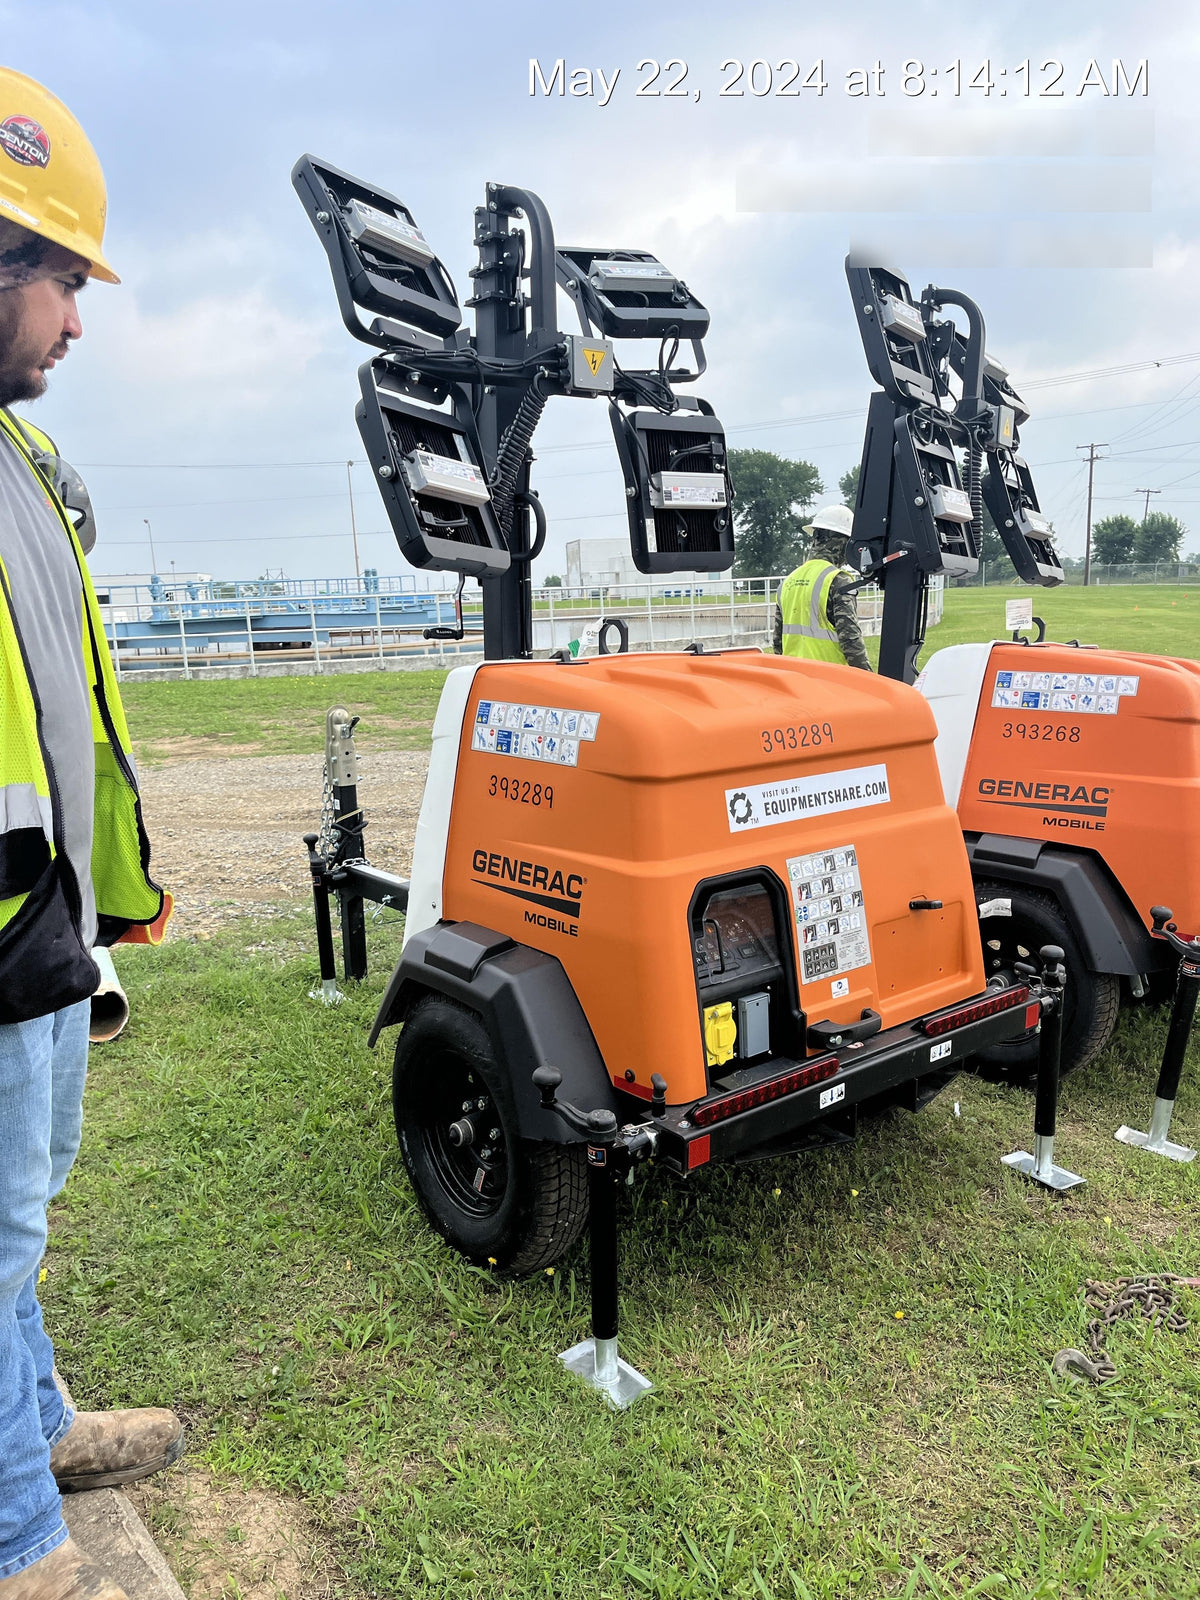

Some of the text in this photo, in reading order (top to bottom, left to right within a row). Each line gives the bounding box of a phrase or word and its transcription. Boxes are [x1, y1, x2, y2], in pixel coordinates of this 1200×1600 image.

[0, 128, 48, 164] DENTON
[761, 722, 834, 753] 393289
[1002, 722, 1081, 743] 393268
[488, 775, 554, 809] 393289
[762, 785, 801, 798] VISIT US AT:
[764, 781, 887, 817] EQUIPMENTSHARE.COM
[978, 778, 1110, 804] GENERAC
[750, 816, 760, 825] TM
[1042, 816, 1106, 831] MOBILE
[472, 849, 583, 899] GENERAC
[524, 910, 579, 937] MOBILE
